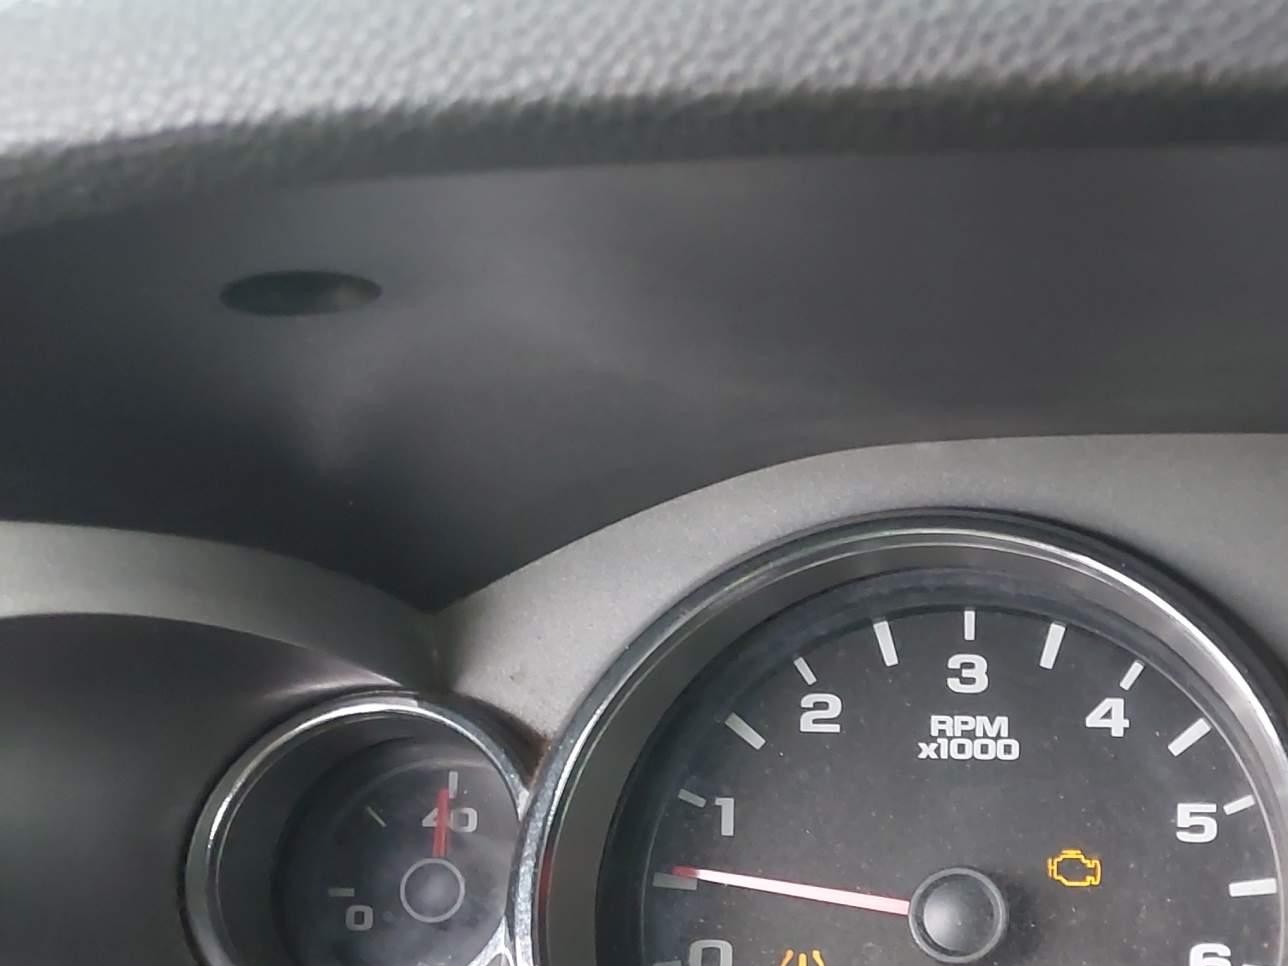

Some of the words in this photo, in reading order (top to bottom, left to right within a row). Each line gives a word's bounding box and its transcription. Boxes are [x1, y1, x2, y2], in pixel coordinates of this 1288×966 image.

[947, 654, 988, 693] 3
[800, 694, 841, 732] 2
[931, 715, 1008, 736] RPM
[1086, 698, 1129, 737] 4
[919, 738, 1019, 760] x1000
[715, 798, 734, 836] 1
[1176, 803, 1217, 842] 5
[346, 905, 373, 930] 0
